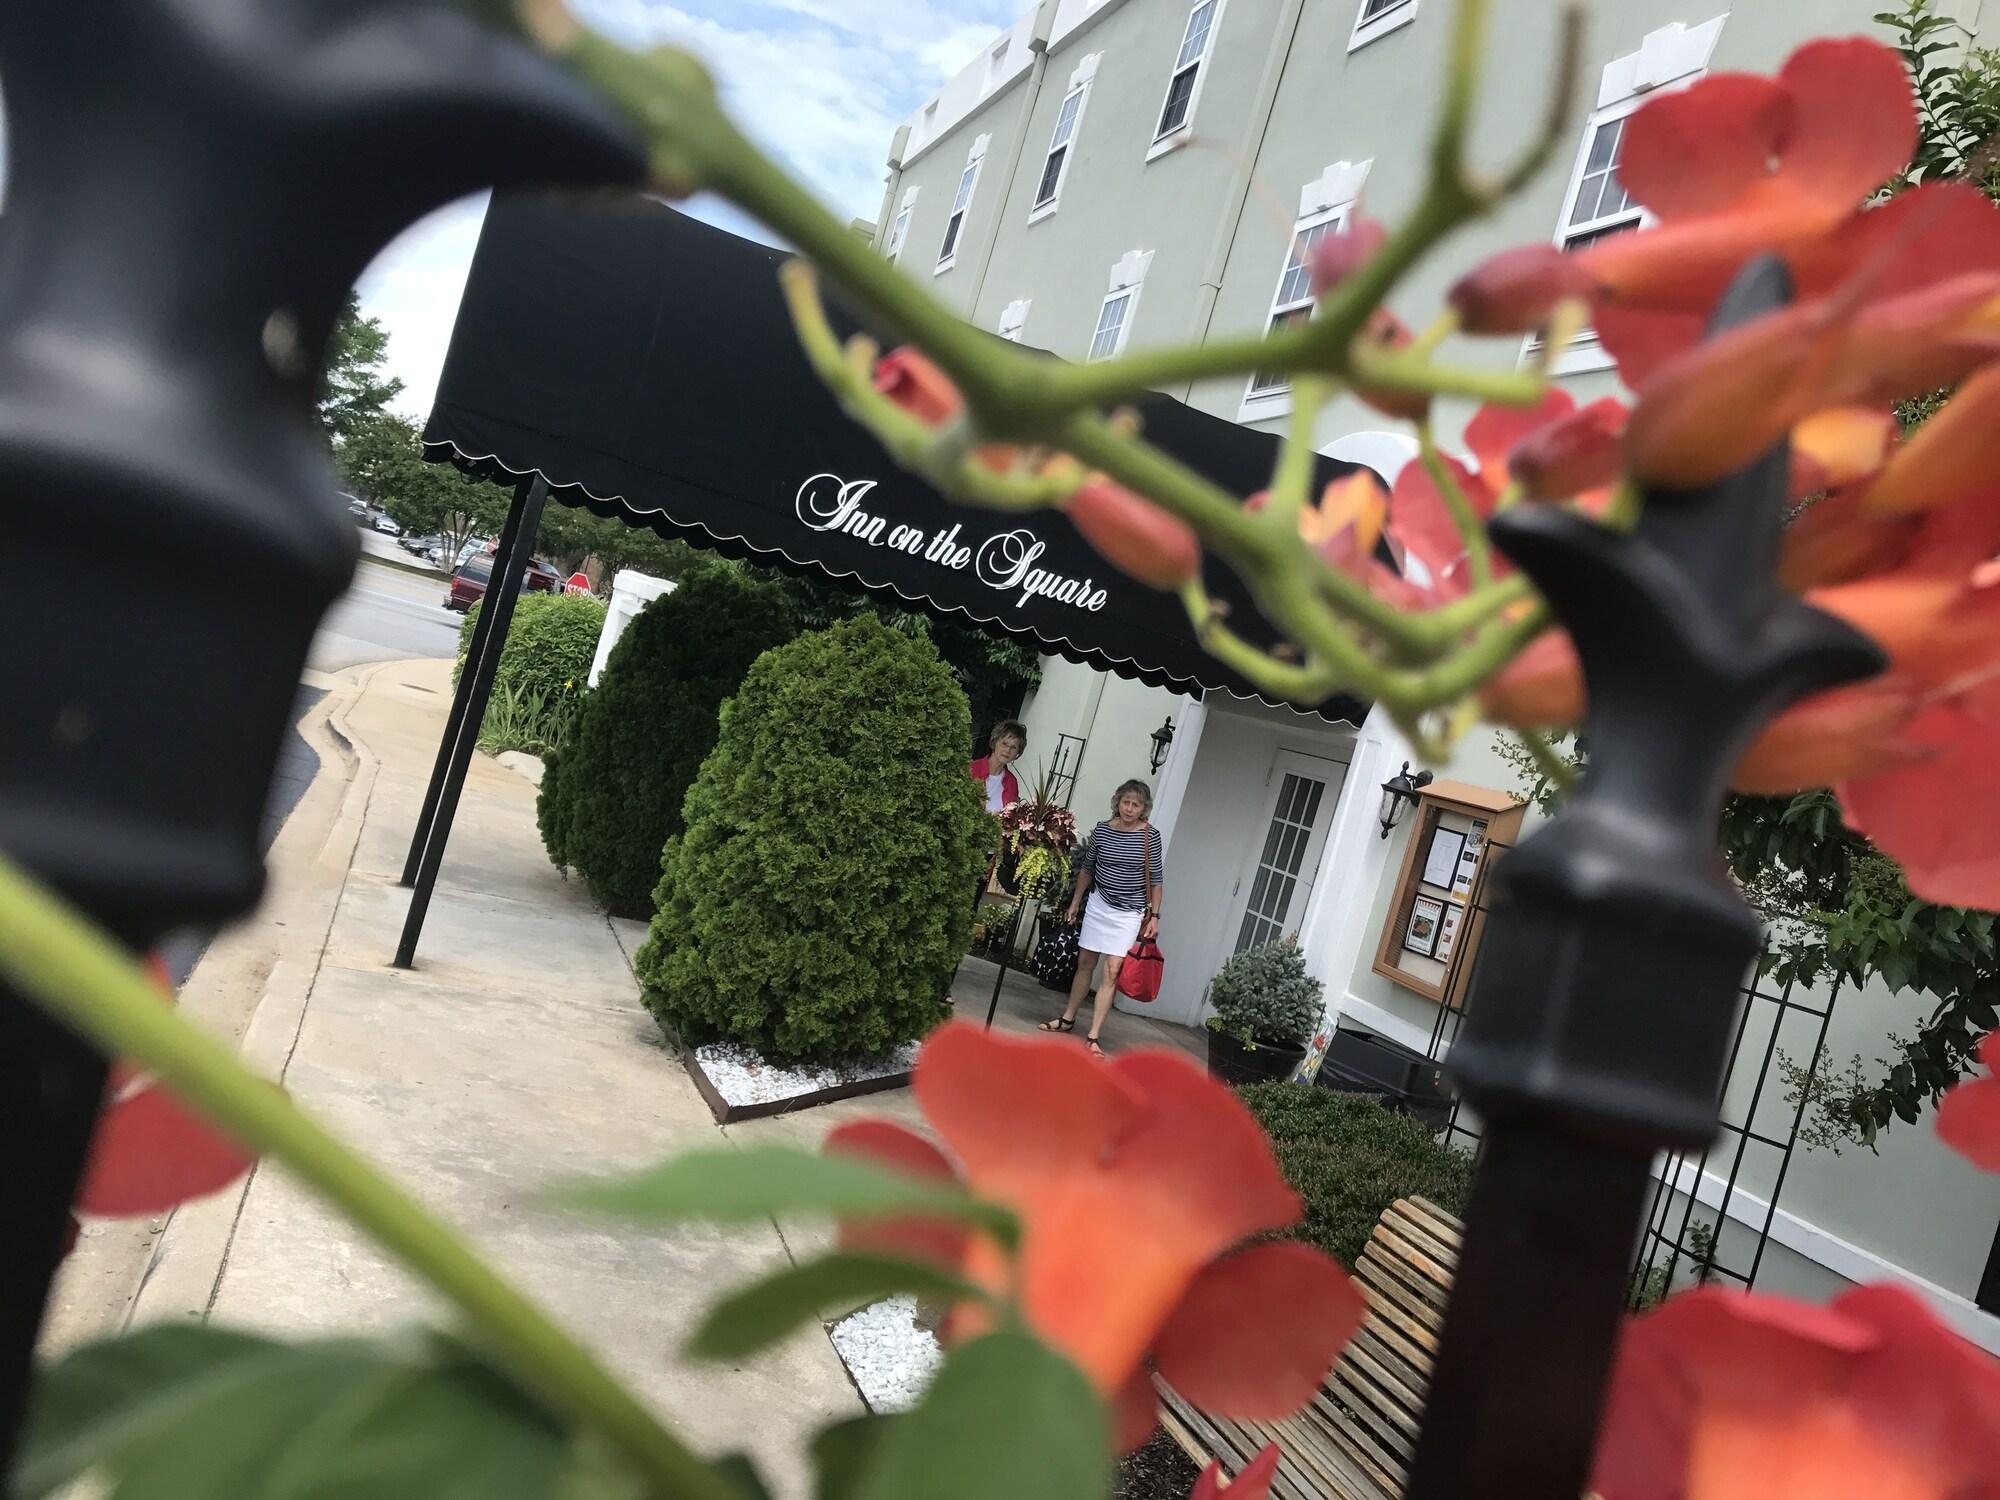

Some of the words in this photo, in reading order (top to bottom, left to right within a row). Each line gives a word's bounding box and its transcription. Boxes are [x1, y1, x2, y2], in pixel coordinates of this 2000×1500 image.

[795, 473, 885, 547] Inn
[887, 524, 925, 555] on
[924, 523, 971, 570] the
[975, 529, 1108, 613] Square
[567, 583, 589, 597] STOP
